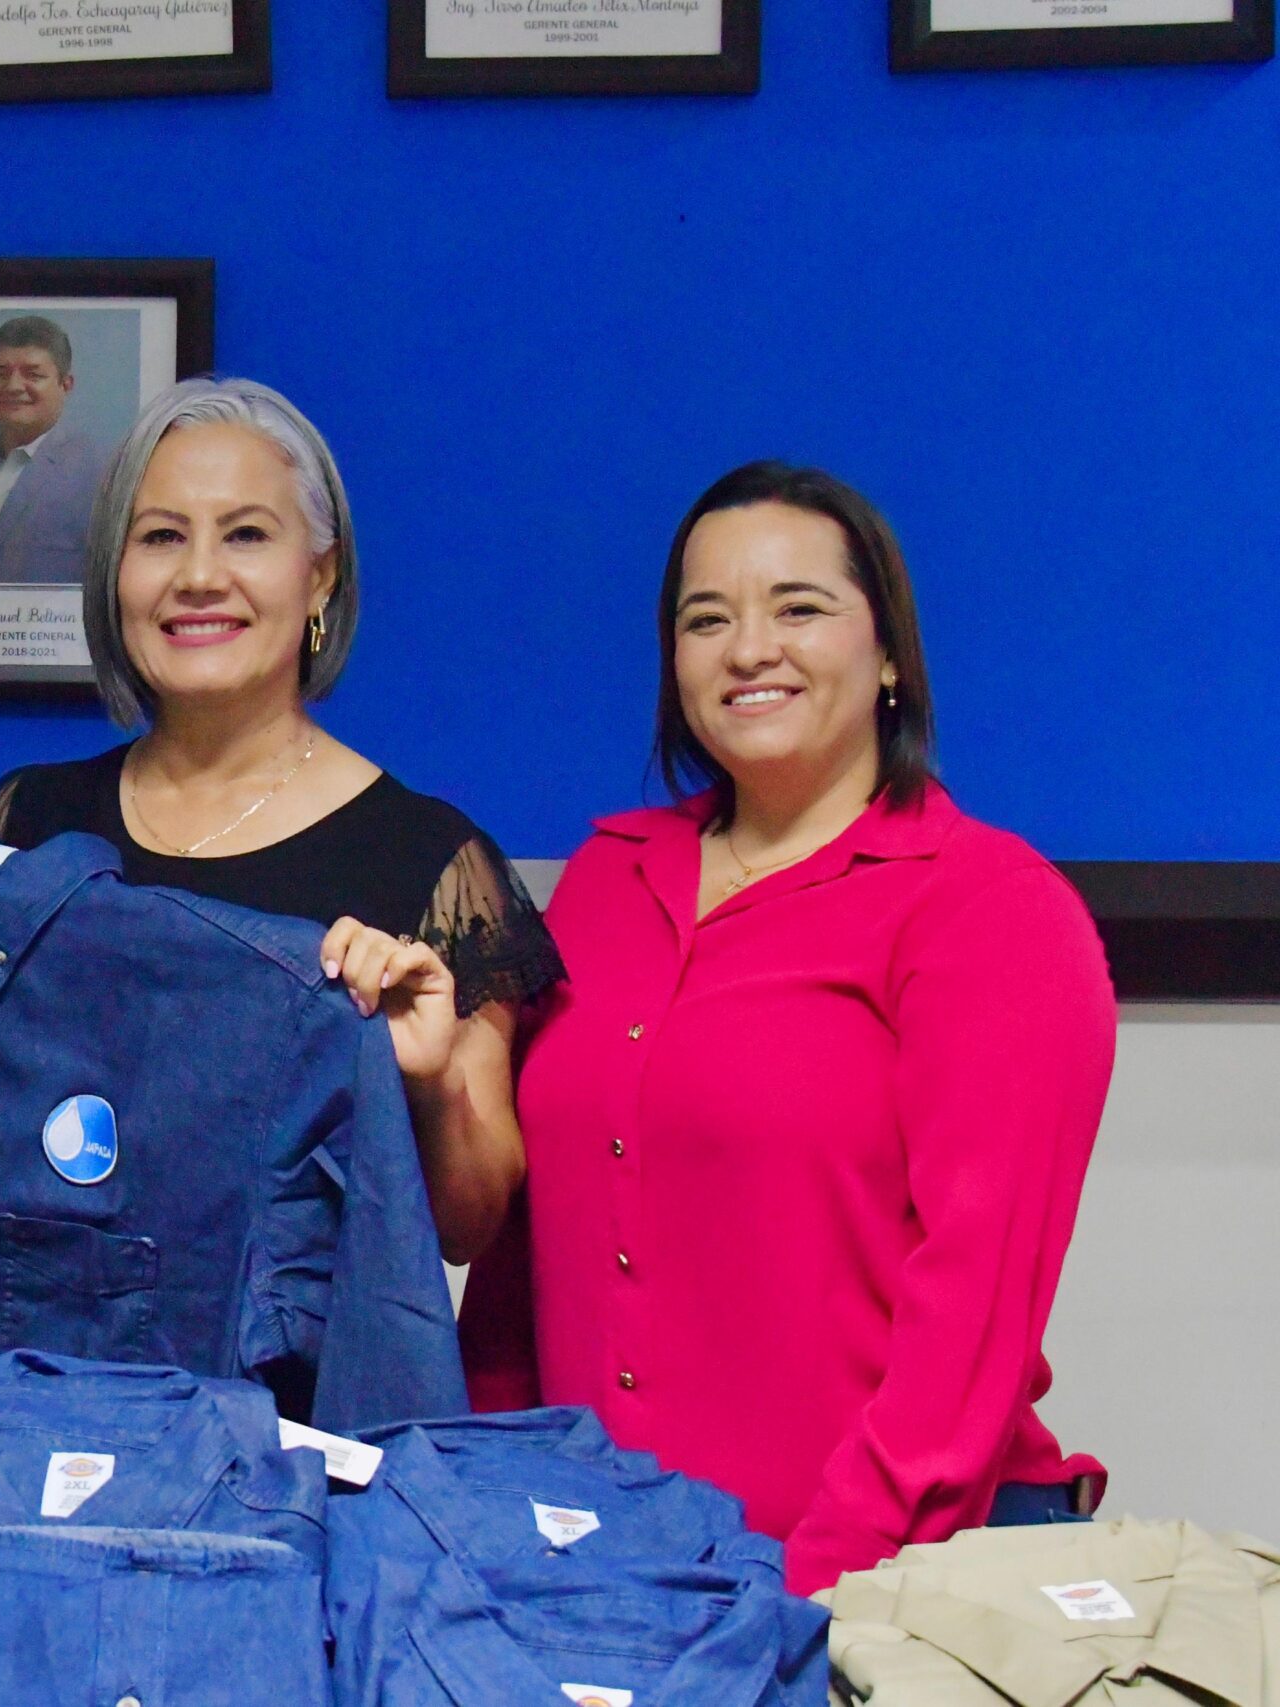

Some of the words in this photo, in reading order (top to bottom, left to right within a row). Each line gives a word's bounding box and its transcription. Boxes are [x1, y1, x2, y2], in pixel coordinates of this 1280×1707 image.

[523, 20, 570, 30] GERENTE
[572, 20, 620, 30] GENERAL
[38, 26, 83, 37] GERENTE
[86, 24, 132, 35] GENERAL
[545, 33, 599, 43] 1999-2001
[58, 38, 113, 49] 1996-1998
[29, 631, 76, 641] GENERAL
[1, 647, 57, 657] 2018-2021
[64, 1481, 90, 1490] 2XL
[561, 1526, 580, 1536] XL
